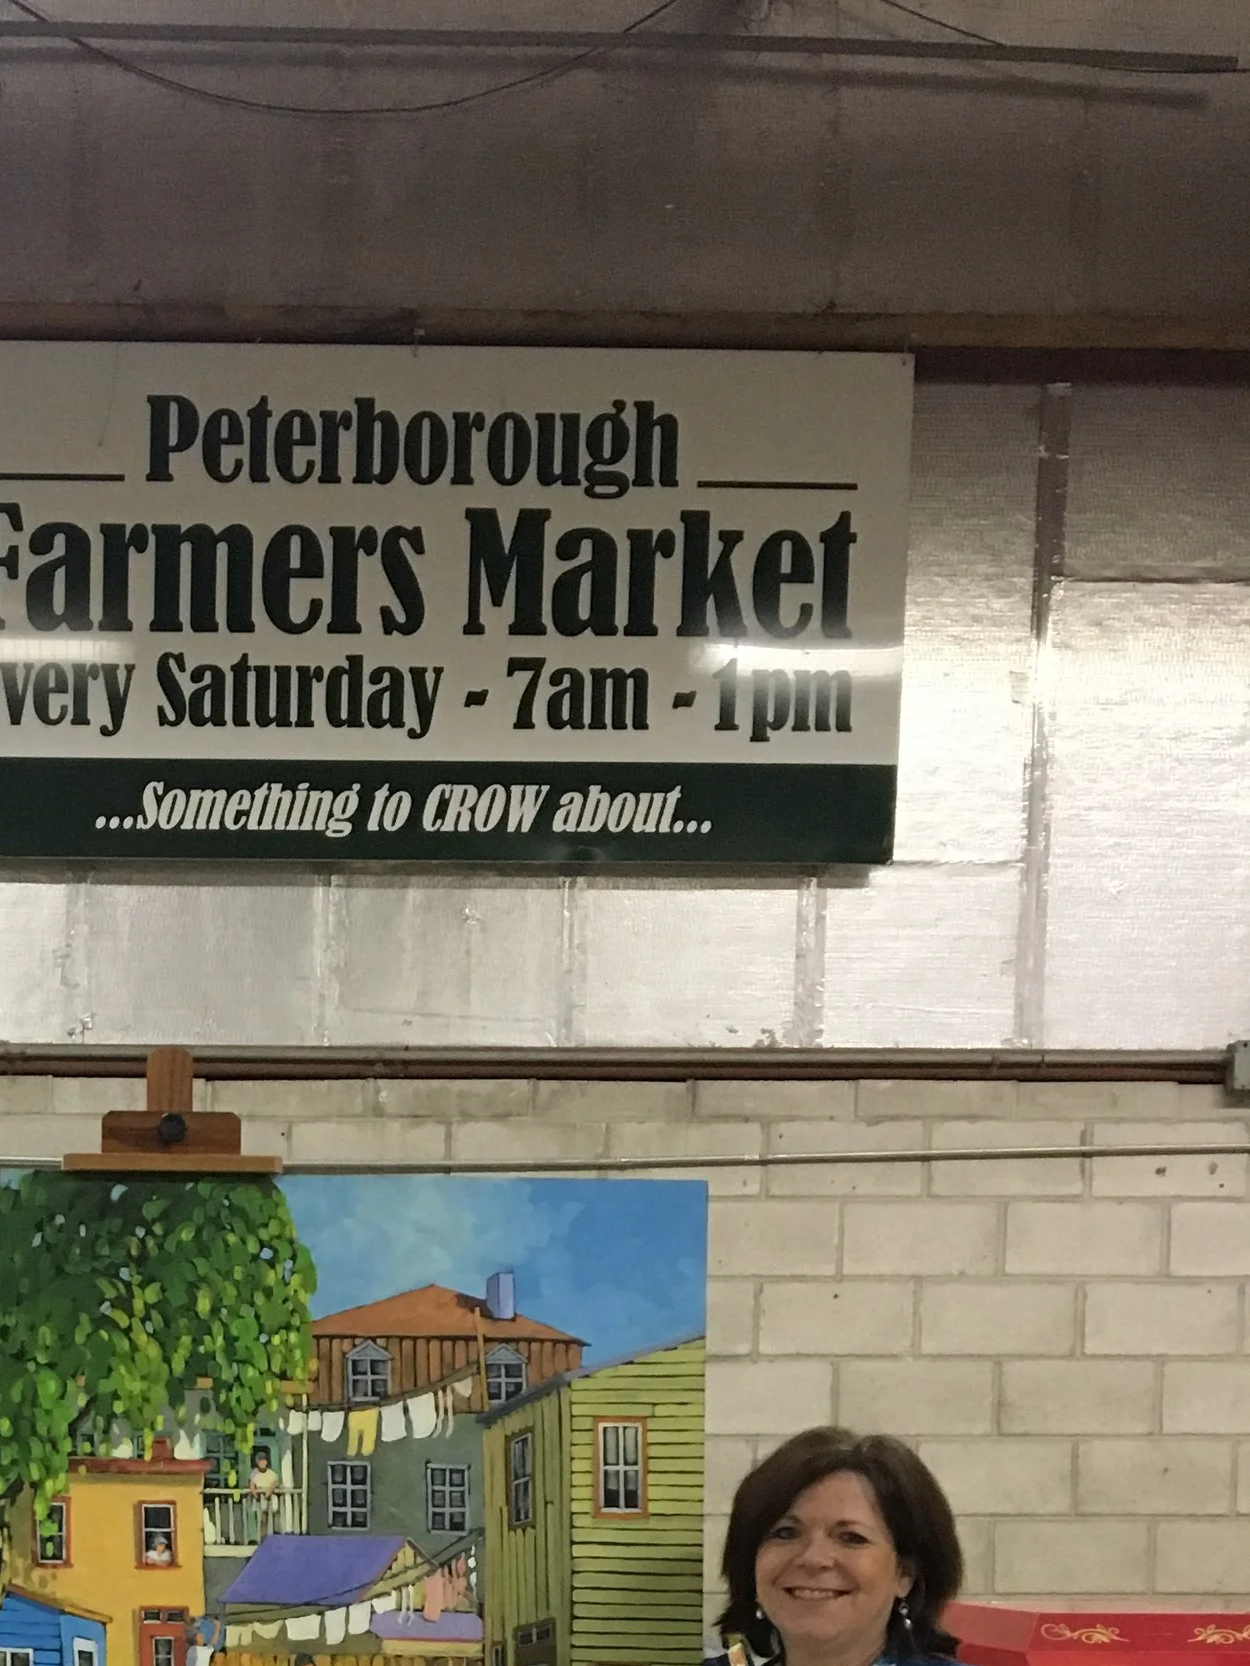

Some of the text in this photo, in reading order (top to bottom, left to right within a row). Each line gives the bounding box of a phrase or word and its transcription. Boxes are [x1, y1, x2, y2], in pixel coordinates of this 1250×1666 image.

[145, 394, 679, 500] Peterborough
[463, 506, 857, 638] Market
[157, 651, 445, 740] Saturday
[463, 687, 489, 708] -
[506, 655, 650, 731] 7am
[672, 690, 696, 710] -
[710, 658, 853, 744] 1pm
[95, 780, 711, 838] ...Something to CROW about...
